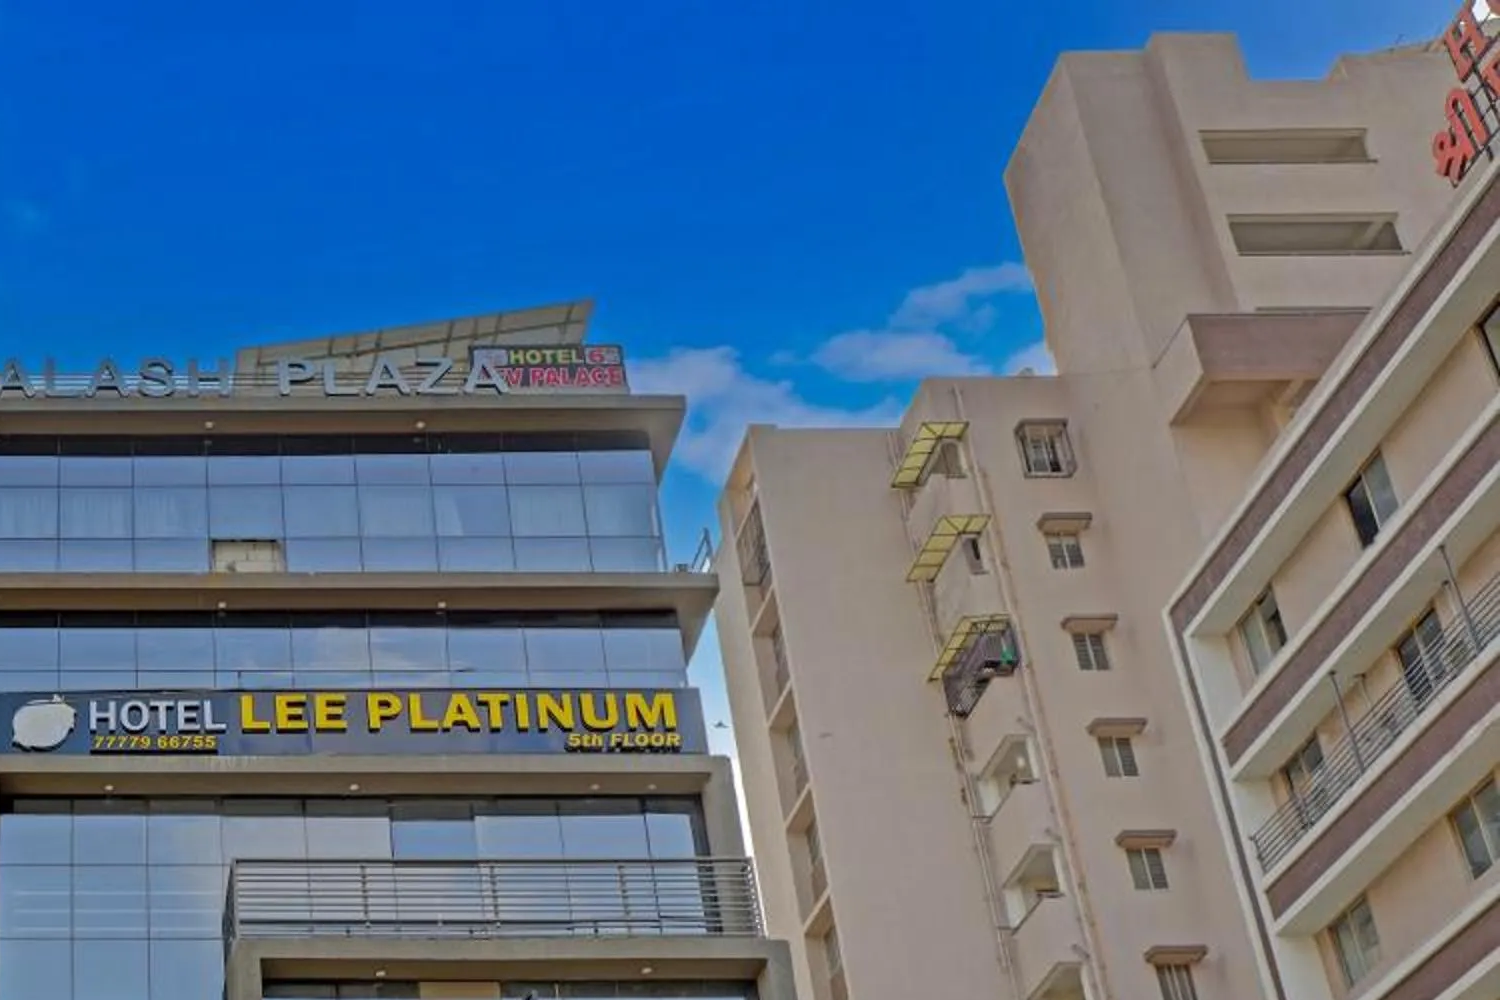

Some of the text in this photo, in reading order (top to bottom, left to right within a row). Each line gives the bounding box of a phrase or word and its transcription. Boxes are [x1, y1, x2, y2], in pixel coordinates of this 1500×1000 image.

[510, 349, 583, 365] HOTEL
[277, 355, 510, 397] PLAZA
[530, 366, 623, 386] PALACE
[89, 691, 678, 733] HOTEL LEE PLATINUM
[94, 735, 218, 749] 77779 66755
[567, 732, 682, 748] 5th FLOOR
